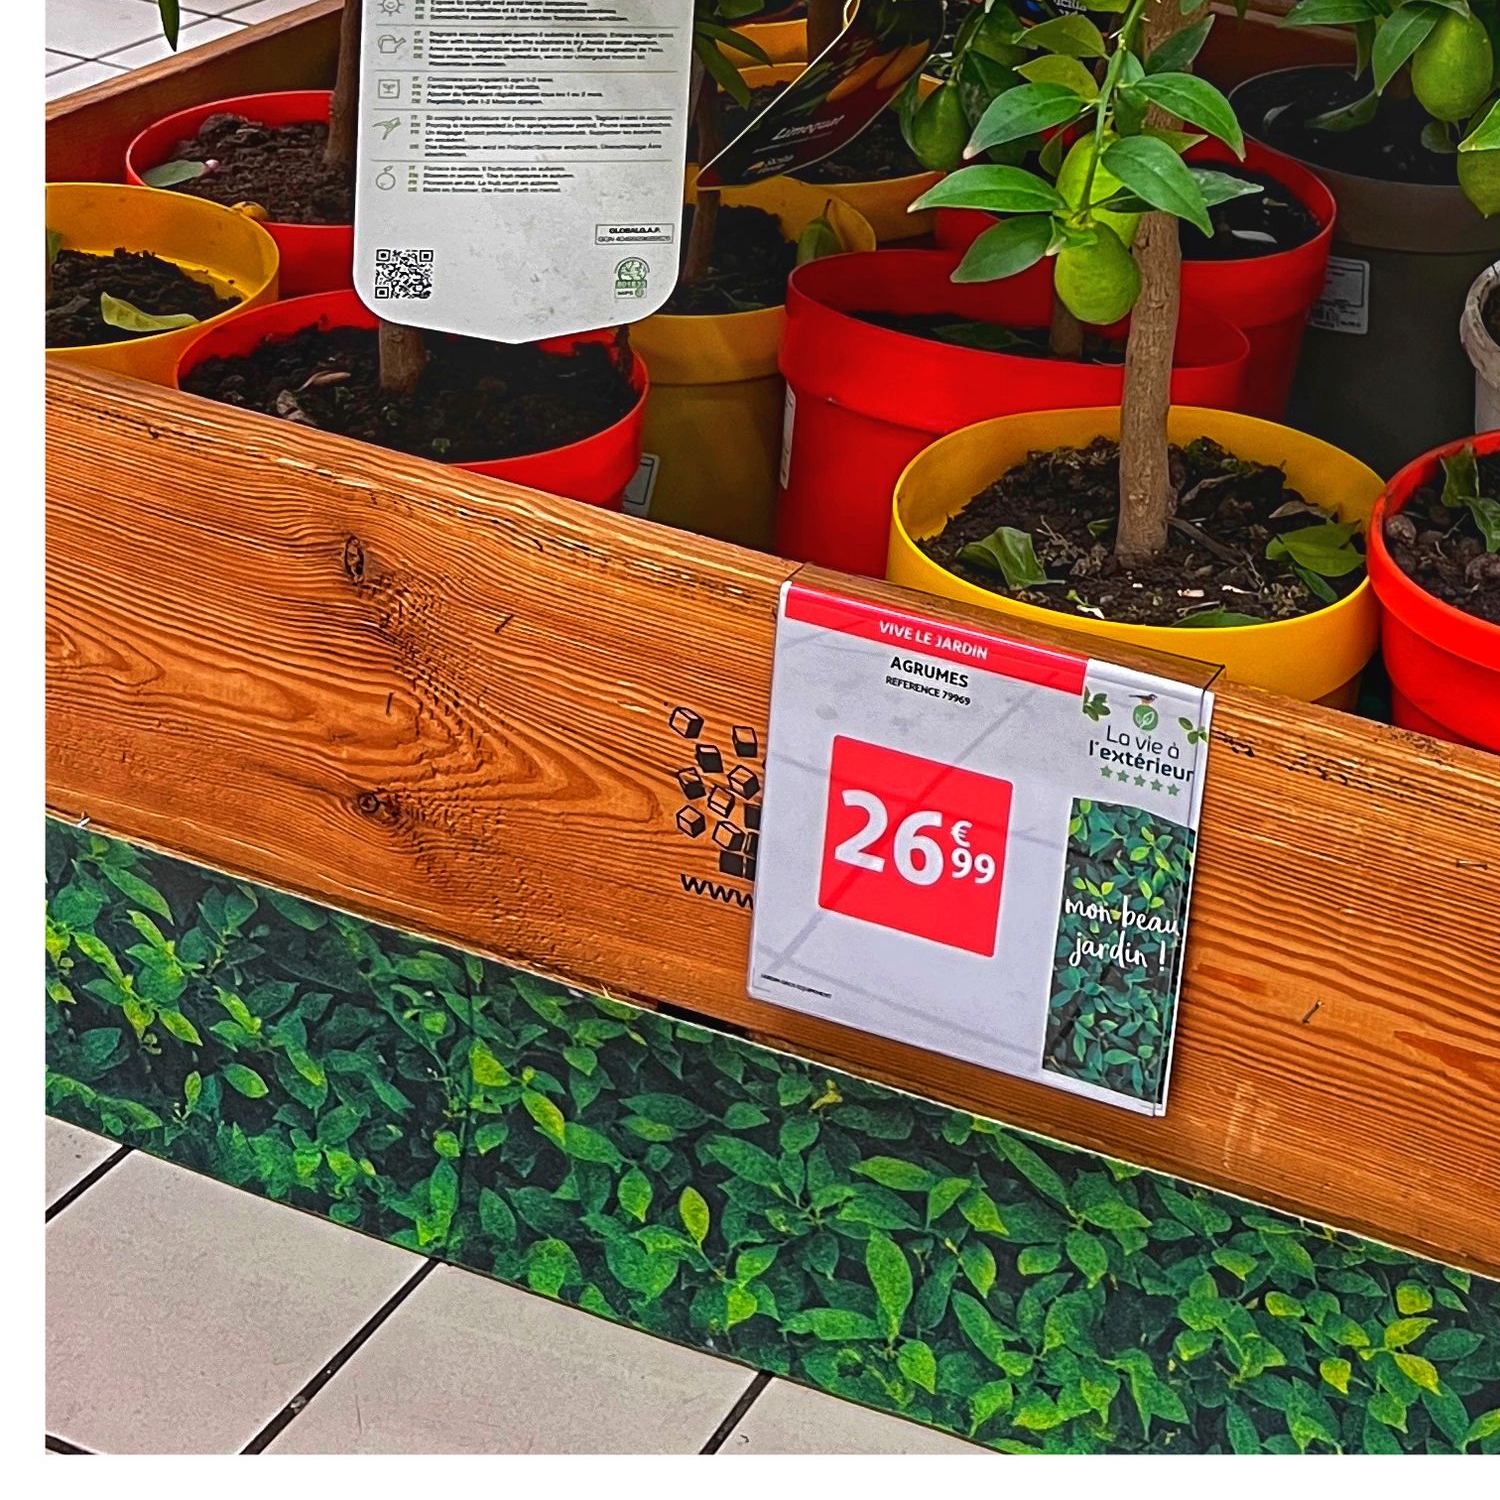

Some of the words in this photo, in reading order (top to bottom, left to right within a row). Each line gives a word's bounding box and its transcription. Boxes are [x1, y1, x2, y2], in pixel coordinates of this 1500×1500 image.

[879, 619, 913, 641] VIVE
[914, 629, 933, 646] LE
[934, 634, 989, 660] JARDIN
[885, 675, 941, 699] REFERENCE
[942, 690, 972, 706] 79969
[890, 656, 970, 688] AGRUMES
[1088, 739, 1196, 783] l'extérieur
[1106, 724, 1131, 747] La
[1135, 735, 1164, 755] vie
[1167, 741, 1180, 760] à
[834, 788, 945, 886] 26
[951, 847, 996, 884] 99
[1064, 897, 1113, 925] mon
[1121, 894, 1181, 937] beau
[1068, 930, 1148, 969] jardin
